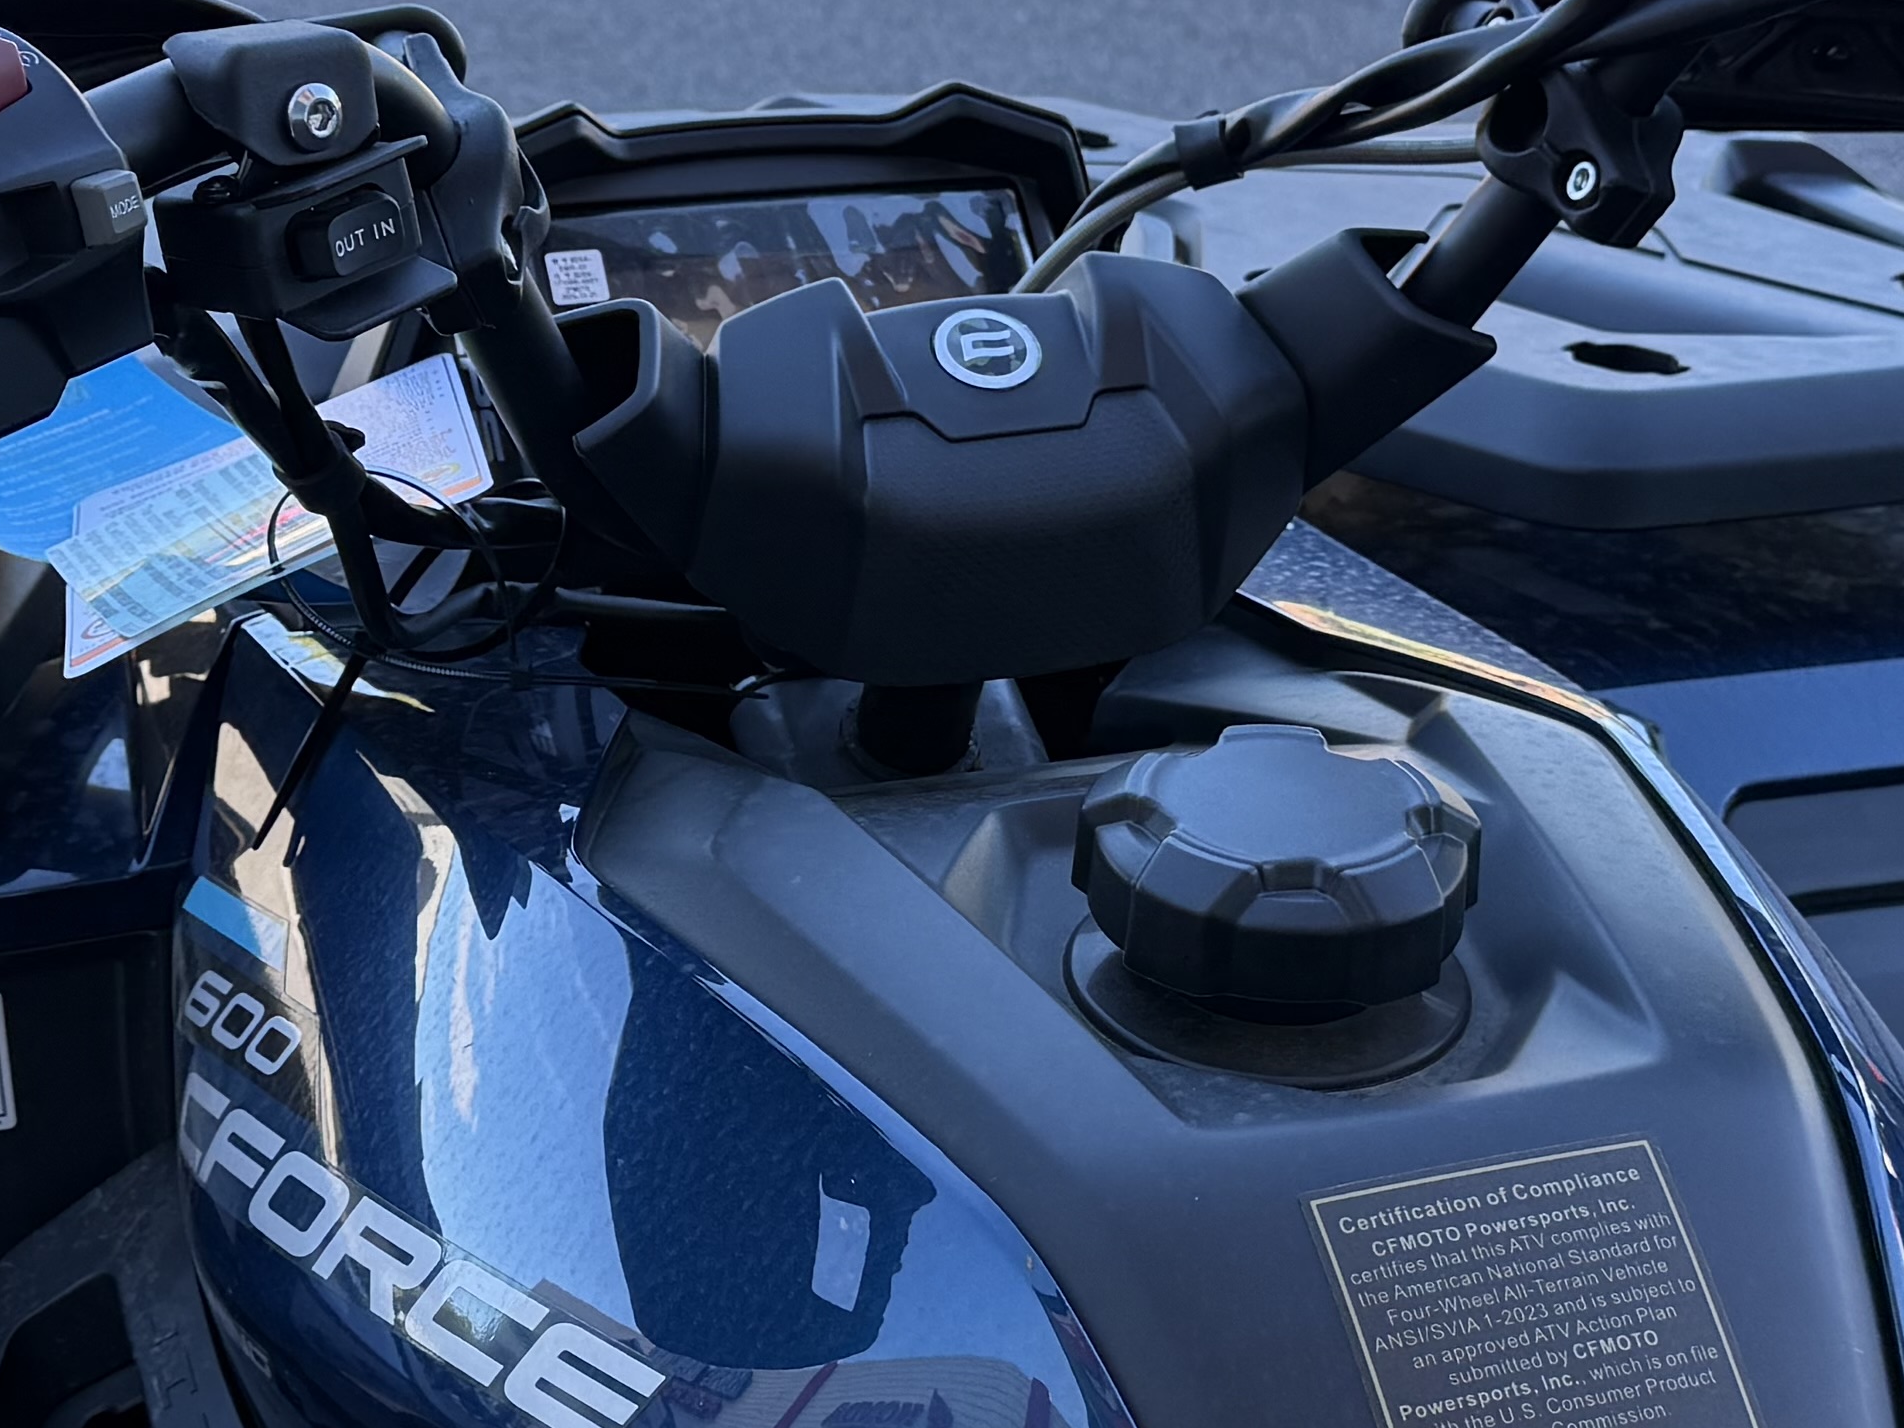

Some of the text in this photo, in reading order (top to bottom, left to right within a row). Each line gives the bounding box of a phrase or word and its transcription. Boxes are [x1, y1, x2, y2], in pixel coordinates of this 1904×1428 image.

[109, 195, 141, 219] MODE
[334, 217, 397, 258] OUT IN
[184, 969, 303, 1077] 600
[1337, 1167, 1641, 1234] Certification of Compliance
[1370, 1197, 1636, 1257] CFMOTO Powersports, Inc.
[1349, 1210, 1672, 1285] certifies that this ATV complies with
[1357, 1233, 1677, 1308] the American National Standard for
[1374, 1277, 1696, 1353] ANSI/SVIA 1-2023 and is subject to
[1385, 1258, 1669, 1326] Four-Wheel All-Terrain Vehicle
[1411, 1305, 1678, 1369] an approved ATV Action Plan
[1448, 1328, 1659, 1386] submitted by CFMOTO
[1398, 1380, 1539, 1422] Powersports,
[1587, 1356, 1643, 1381] which
[1643, 1353, 1662, 1371] is
[1664, 1351, 1689, 1367] on
[1689, 1343, 1719, 1363] file
[1545, 1383, 1641, 1415] Consumer
[1643, 1366, 1717, 1396] Product
